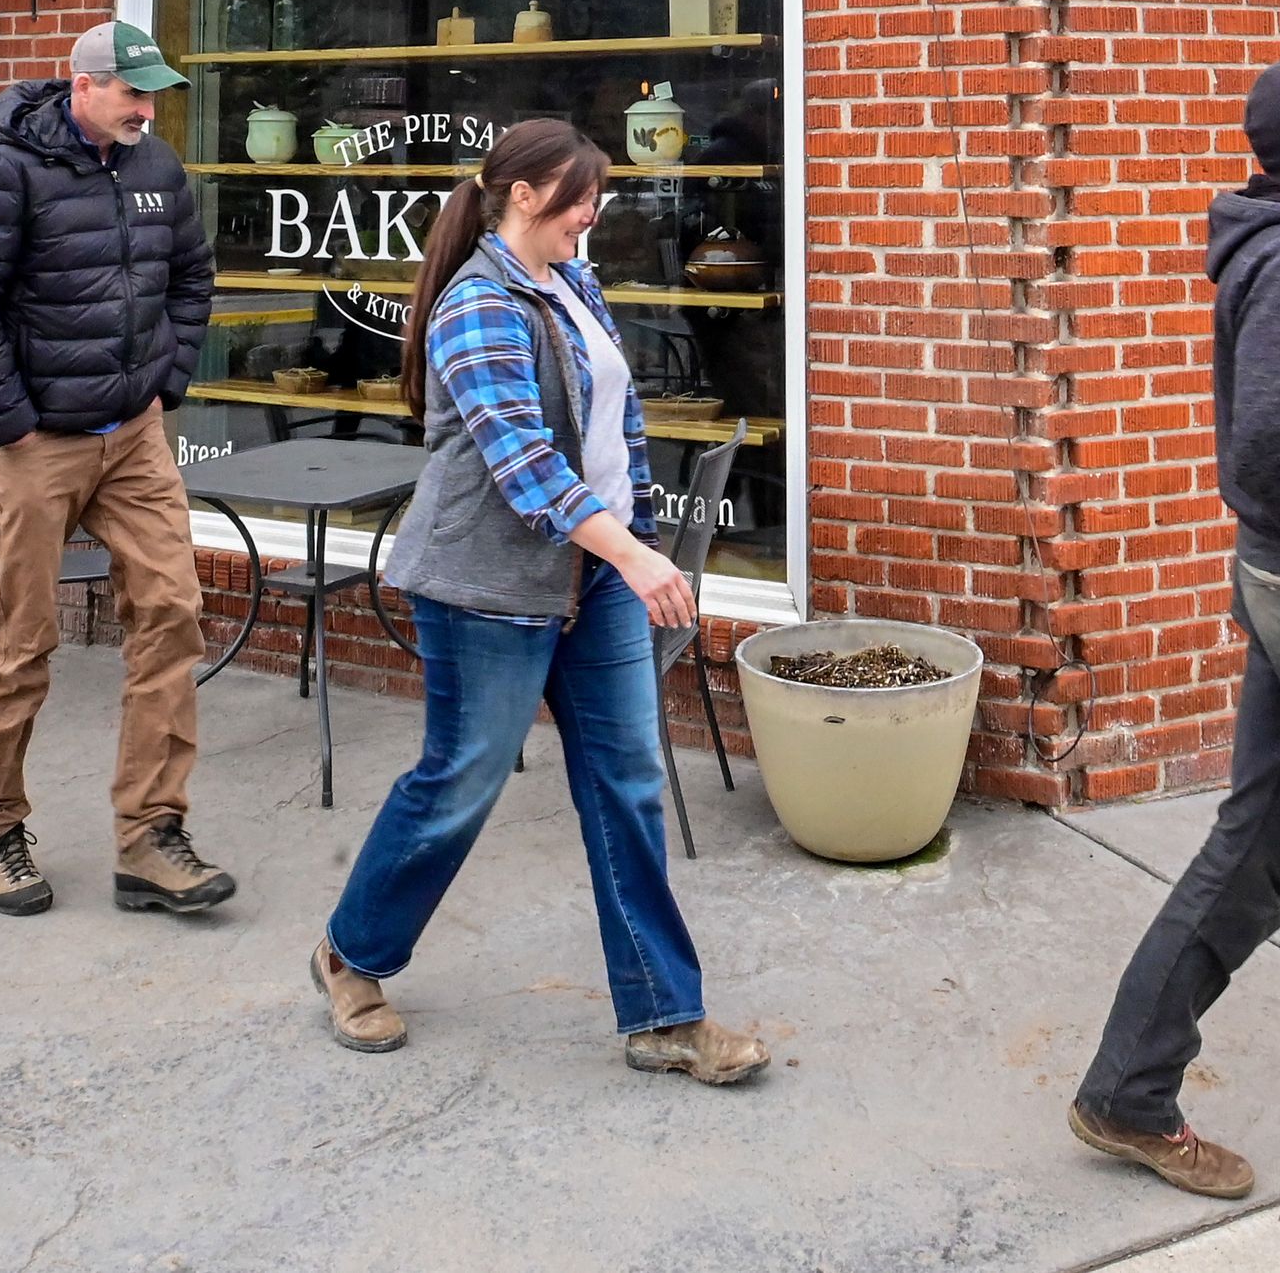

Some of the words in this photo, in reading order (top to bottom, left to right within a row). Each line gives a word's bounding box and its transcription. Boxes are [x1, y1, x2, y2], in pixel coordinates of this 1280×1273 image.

[333, 120, 395, 168] THE
[402, 113, 452, 145] PIE
[460, 116, 508, 151] SA
[264, 188, 618, 268] BAKY
[346, 282, 363, 304] &
[365, 292, 414, 325] KITC
